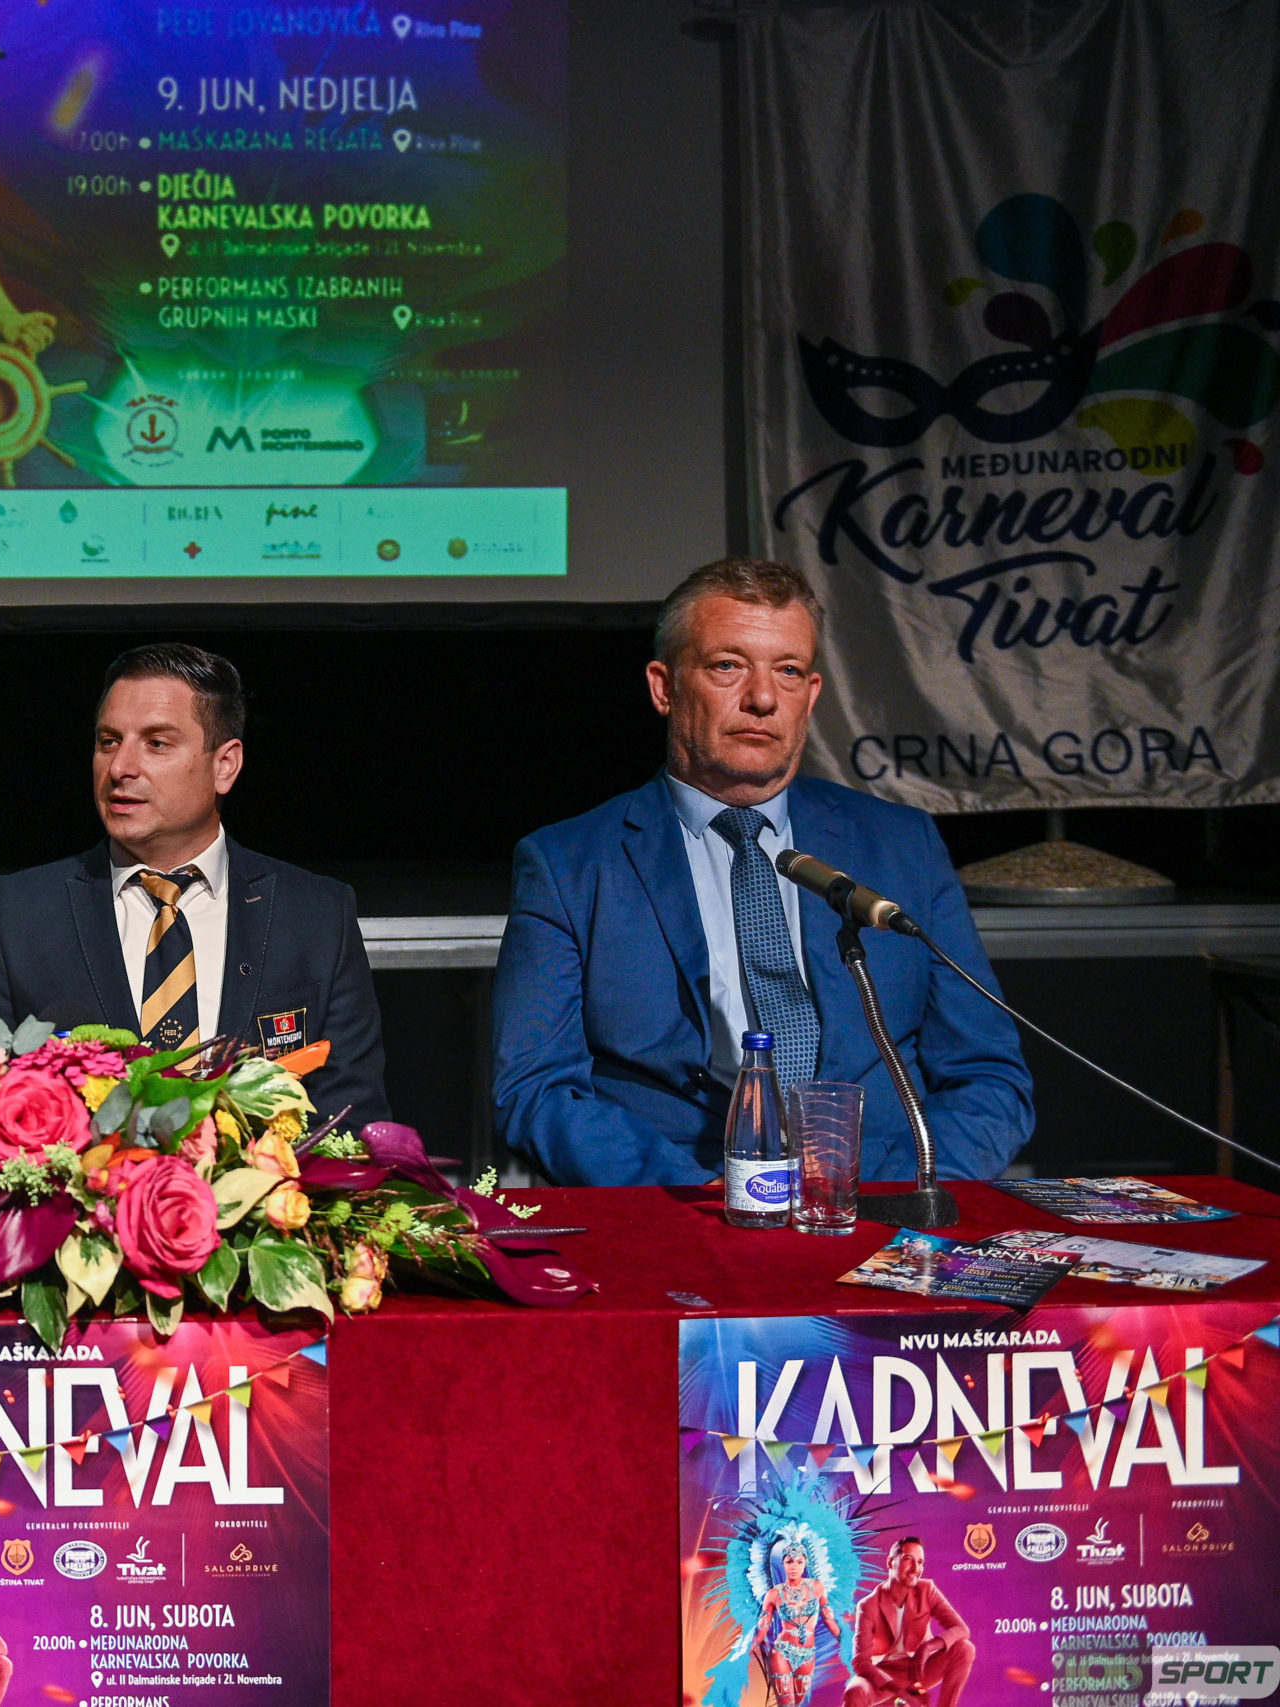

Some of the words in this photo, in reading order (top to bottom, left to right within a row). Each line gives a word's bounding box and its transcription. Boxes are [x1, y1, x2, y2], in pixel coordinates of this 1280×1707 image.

[158, 77, 183, 111] 9.
[198, 77, 265, 114] JUN,
[278, 76, 419, 115] NEDJELJA
[157, 168, 236, 201] DJEČIJA
[157, 204, 314, 230] KARNEVALSKA
[324, 204, 432, 230] POVORKA
[157, 277, 288, 298] PERFORMANS
[297, 276, 404, 298] IZABRANIH
[158, 305, 249, 328] GRUPNIH
[256, 305, 318, 328] MASKI
[941, 442, 1190, 480] MEĐUNARODNI
[773, 451, 1218, 585] Karneval
[927, 550, 1181, 665] Tivat
[850, 732, 1021, 782] CRNA
[1042, 725, 1225, 777] GORA
[952, 1245, 1072, 1265] KARNEVAL
[900, 1334, 939, 1350] NVU
[943, 1328, 1061, 1348] MAŠKARADA
[738, 1346, 1240, 1497] KARNEVAL
[1076, 1543, 1125, 1558] Tivat
[116, 1562, 167, 1576] Tivat
[204, 1564, 241, 1573] SALON
[952, 1562, 984, 1571] OPŠTINA
[986, 1561, 1007, 1570] TIVAT
[23, 1577, 45, 1586] TIVAT
[1050, 1586, 1069, 1610] 8.
[1075, 1585, 1116, 1612] JUN,
[1121, 1583, 1193, 1608] SUBOTA
[90, 1605, 108, 1628] 8.
[115, 1604, 156, 1630] JUN,
[162, 1604, 235, 1628] SUBOTA
[994, 1618, 1036, 1634] 20.00h
[1051, 1615, 1148, 1633] MEĐUNARODNA
[33, 1636, 76, 1650] 20.00h
[90, 1634, 189, 1651] MEĐUNARODNA
[1051, 1634, 1140, 1651] KARNEVALSKA
[1146, 1630, 1208, 1649] POVORKA
[91, 1653, 180, 1669] KARNEVALSKA
[187, 1652, 249, 1668] POVORKA
[120, 1675, 126, 1685] II
[128, 1673, 180, 1686] Dalmatinske
[182, 1673, 216, 1688] brigade
[223, 1673, 235, 1685] 21.
[237, 1673, 282, 1685] Novembra
[1052, 1675, 1129, 1693] PERFORMANS
